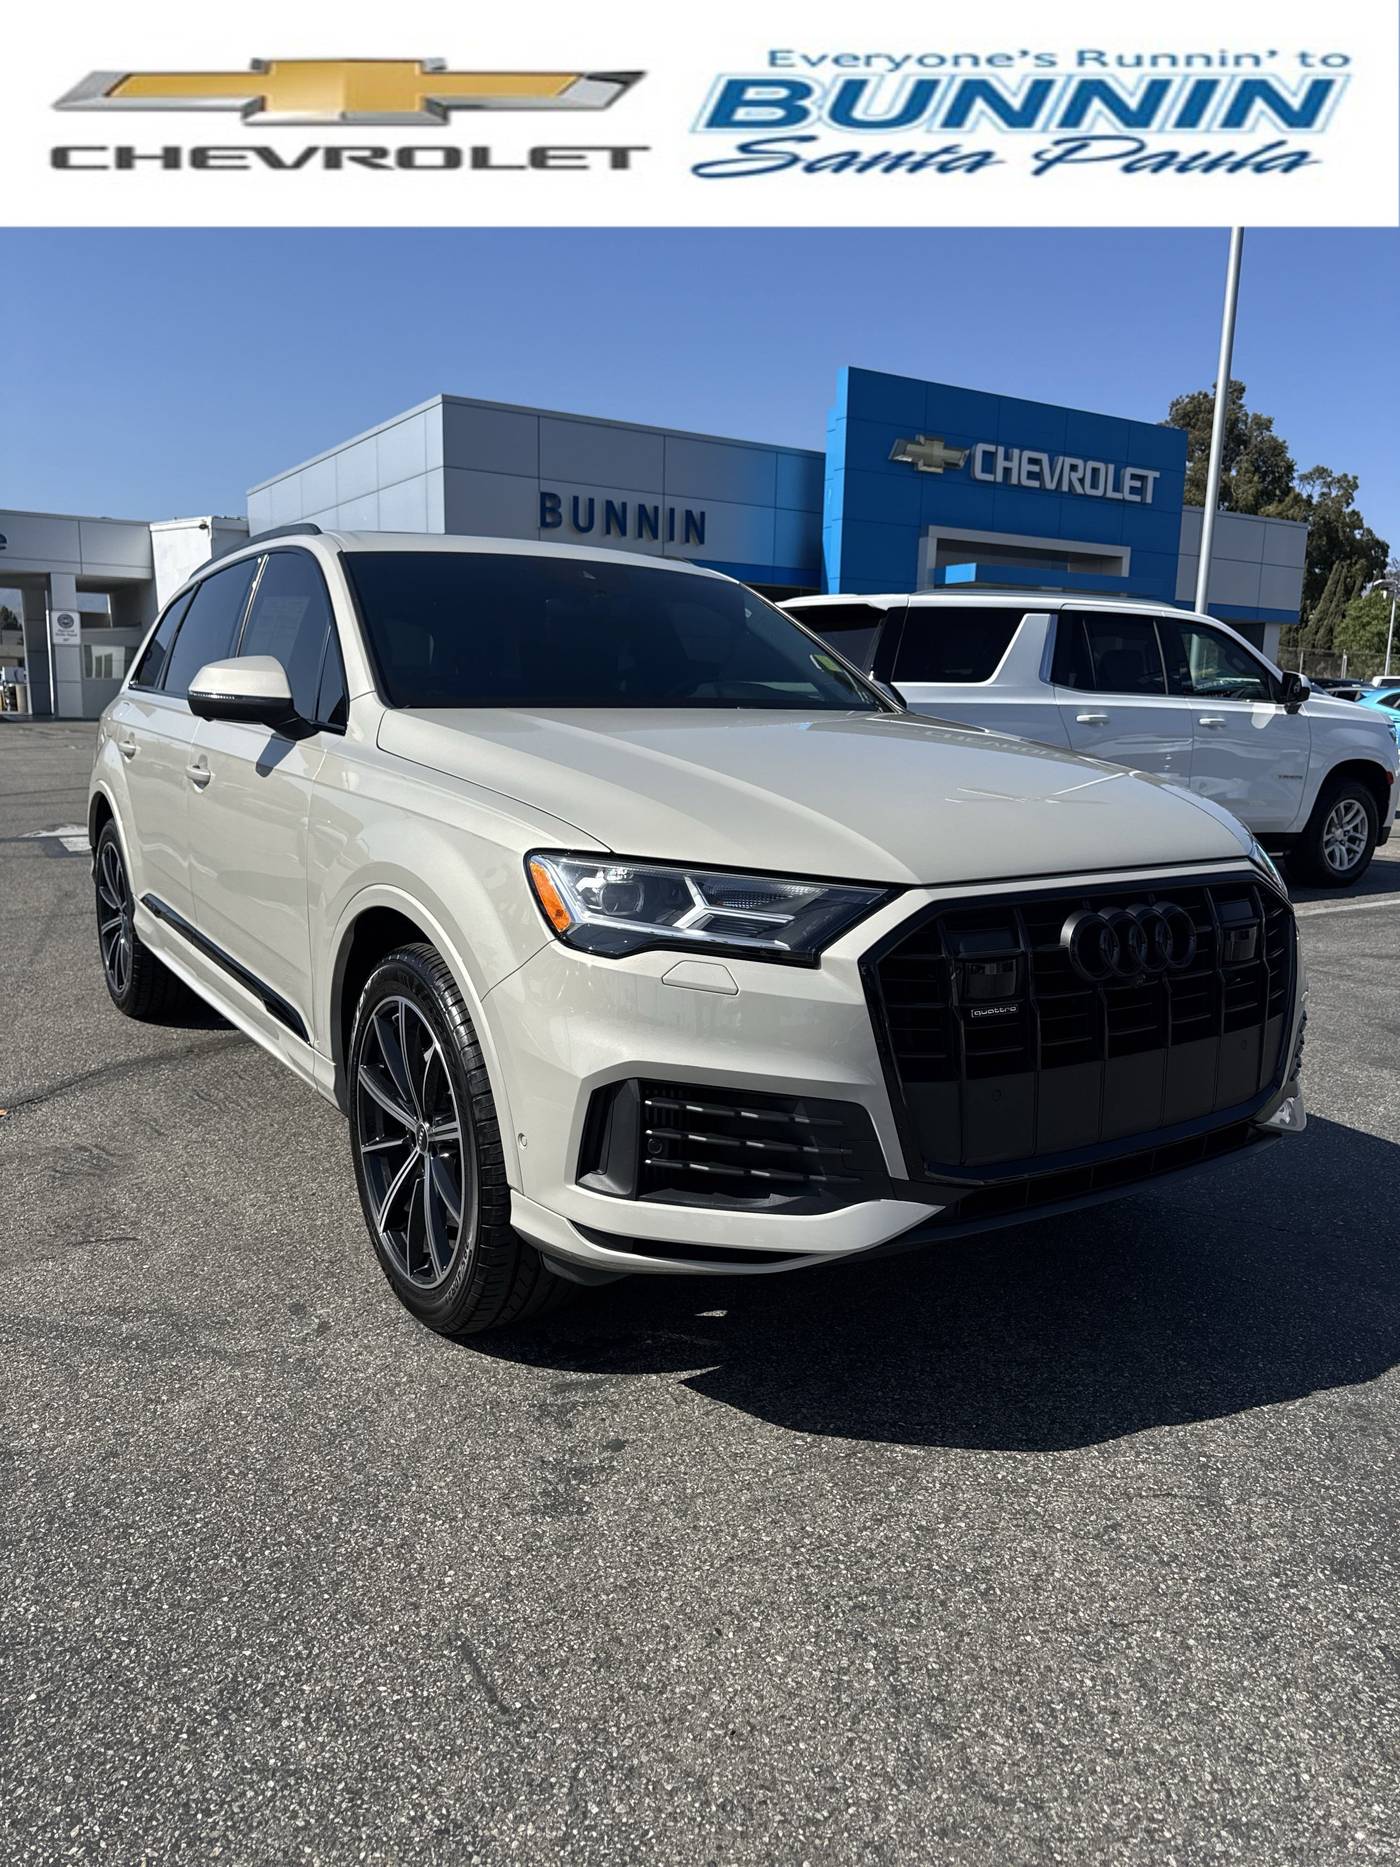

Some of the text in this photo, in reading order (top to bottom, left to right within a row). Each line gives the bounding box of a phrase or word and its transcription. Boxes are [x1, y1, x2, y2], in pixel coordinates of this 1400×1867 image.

[971, 442, 1161, 505] CHEVROLET
[539, 491, 706, 546] BUNNIN
[972, 1006, 1017, 1016] quattro
